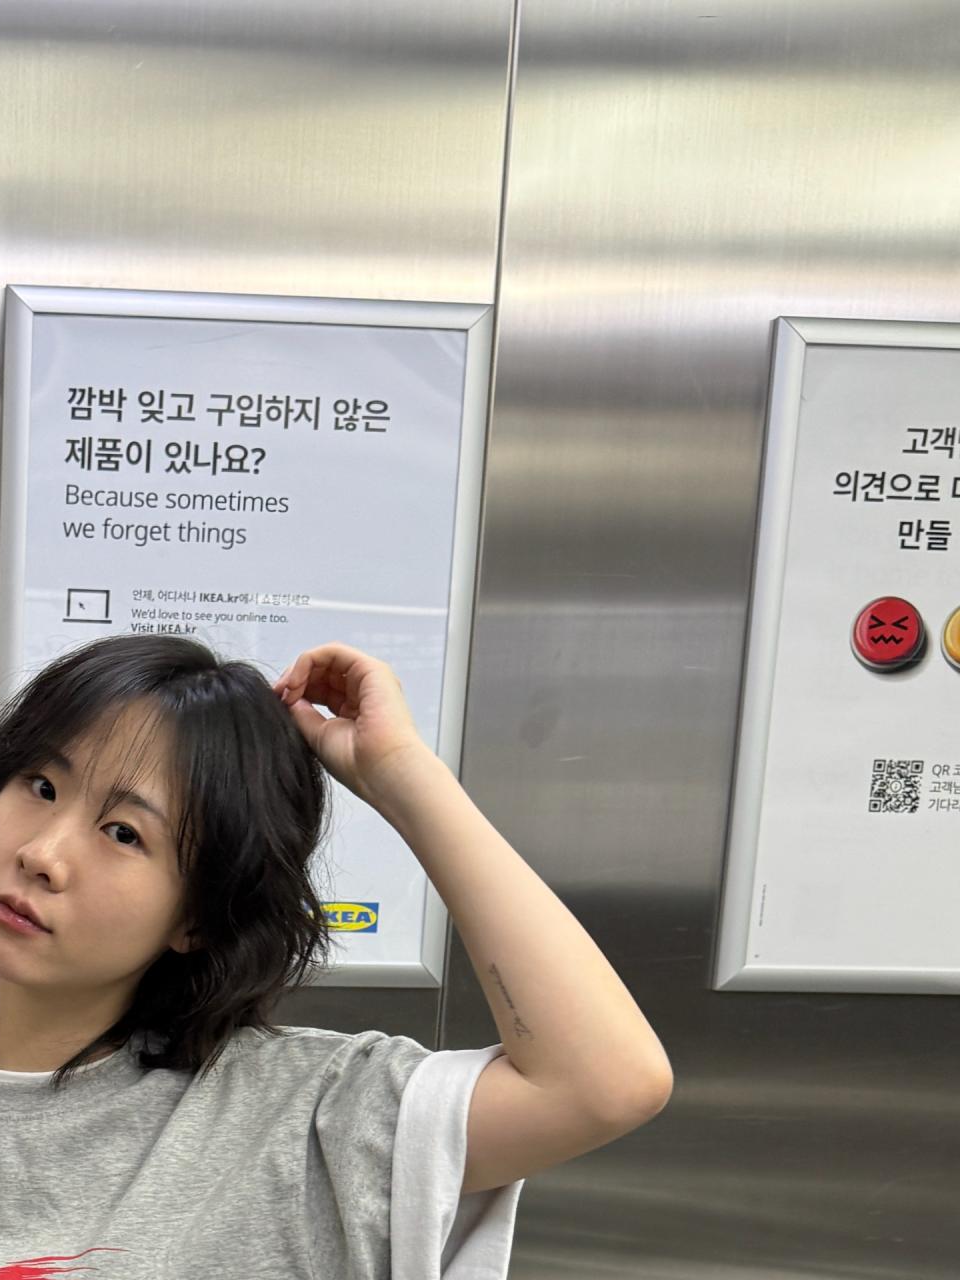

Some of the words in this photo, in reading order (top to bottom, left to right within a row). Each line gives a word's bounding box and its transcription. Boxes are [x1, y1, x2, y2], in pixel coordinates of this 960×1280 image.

[67, 387, 127, 423] 깜박
[137, 389, 197, 424] 잊고
[206, 393, 321, 430] 구입하지
[333, 398, 391, 433] 않은
[64, 438, 152, 473] 제품이
[164, 440, 267, 476] 있나요?
[902, 427, 960, 459] 고객
[65, 484, 159, 508] Because
[165, 489, 290, 513] sometimes
[833, 469, 941, 502] 의견으로
[63, 520, 96, 539] we
[102, 518, 171, 547] forget
[178, 521, 248, 550] things
[898, 519, 953, 551] 만들
[132, 589, 155, 602] 언제,
[158, 590, 197, 603] 어디서나
[131, 608, 156, 620] We'd
[158, 609, 179, 621] love
[182, 610, 193, 621] to
[195, 613, 212, 622] see
[214, 613, 234, 625] you
[236, 612, 268, 623] online
[269, 613, 289, 624] too.
[131, 623, 155, 633] Visit
[931, 764, 951, 778] QR
[322, 911, 372, 924] KEA
